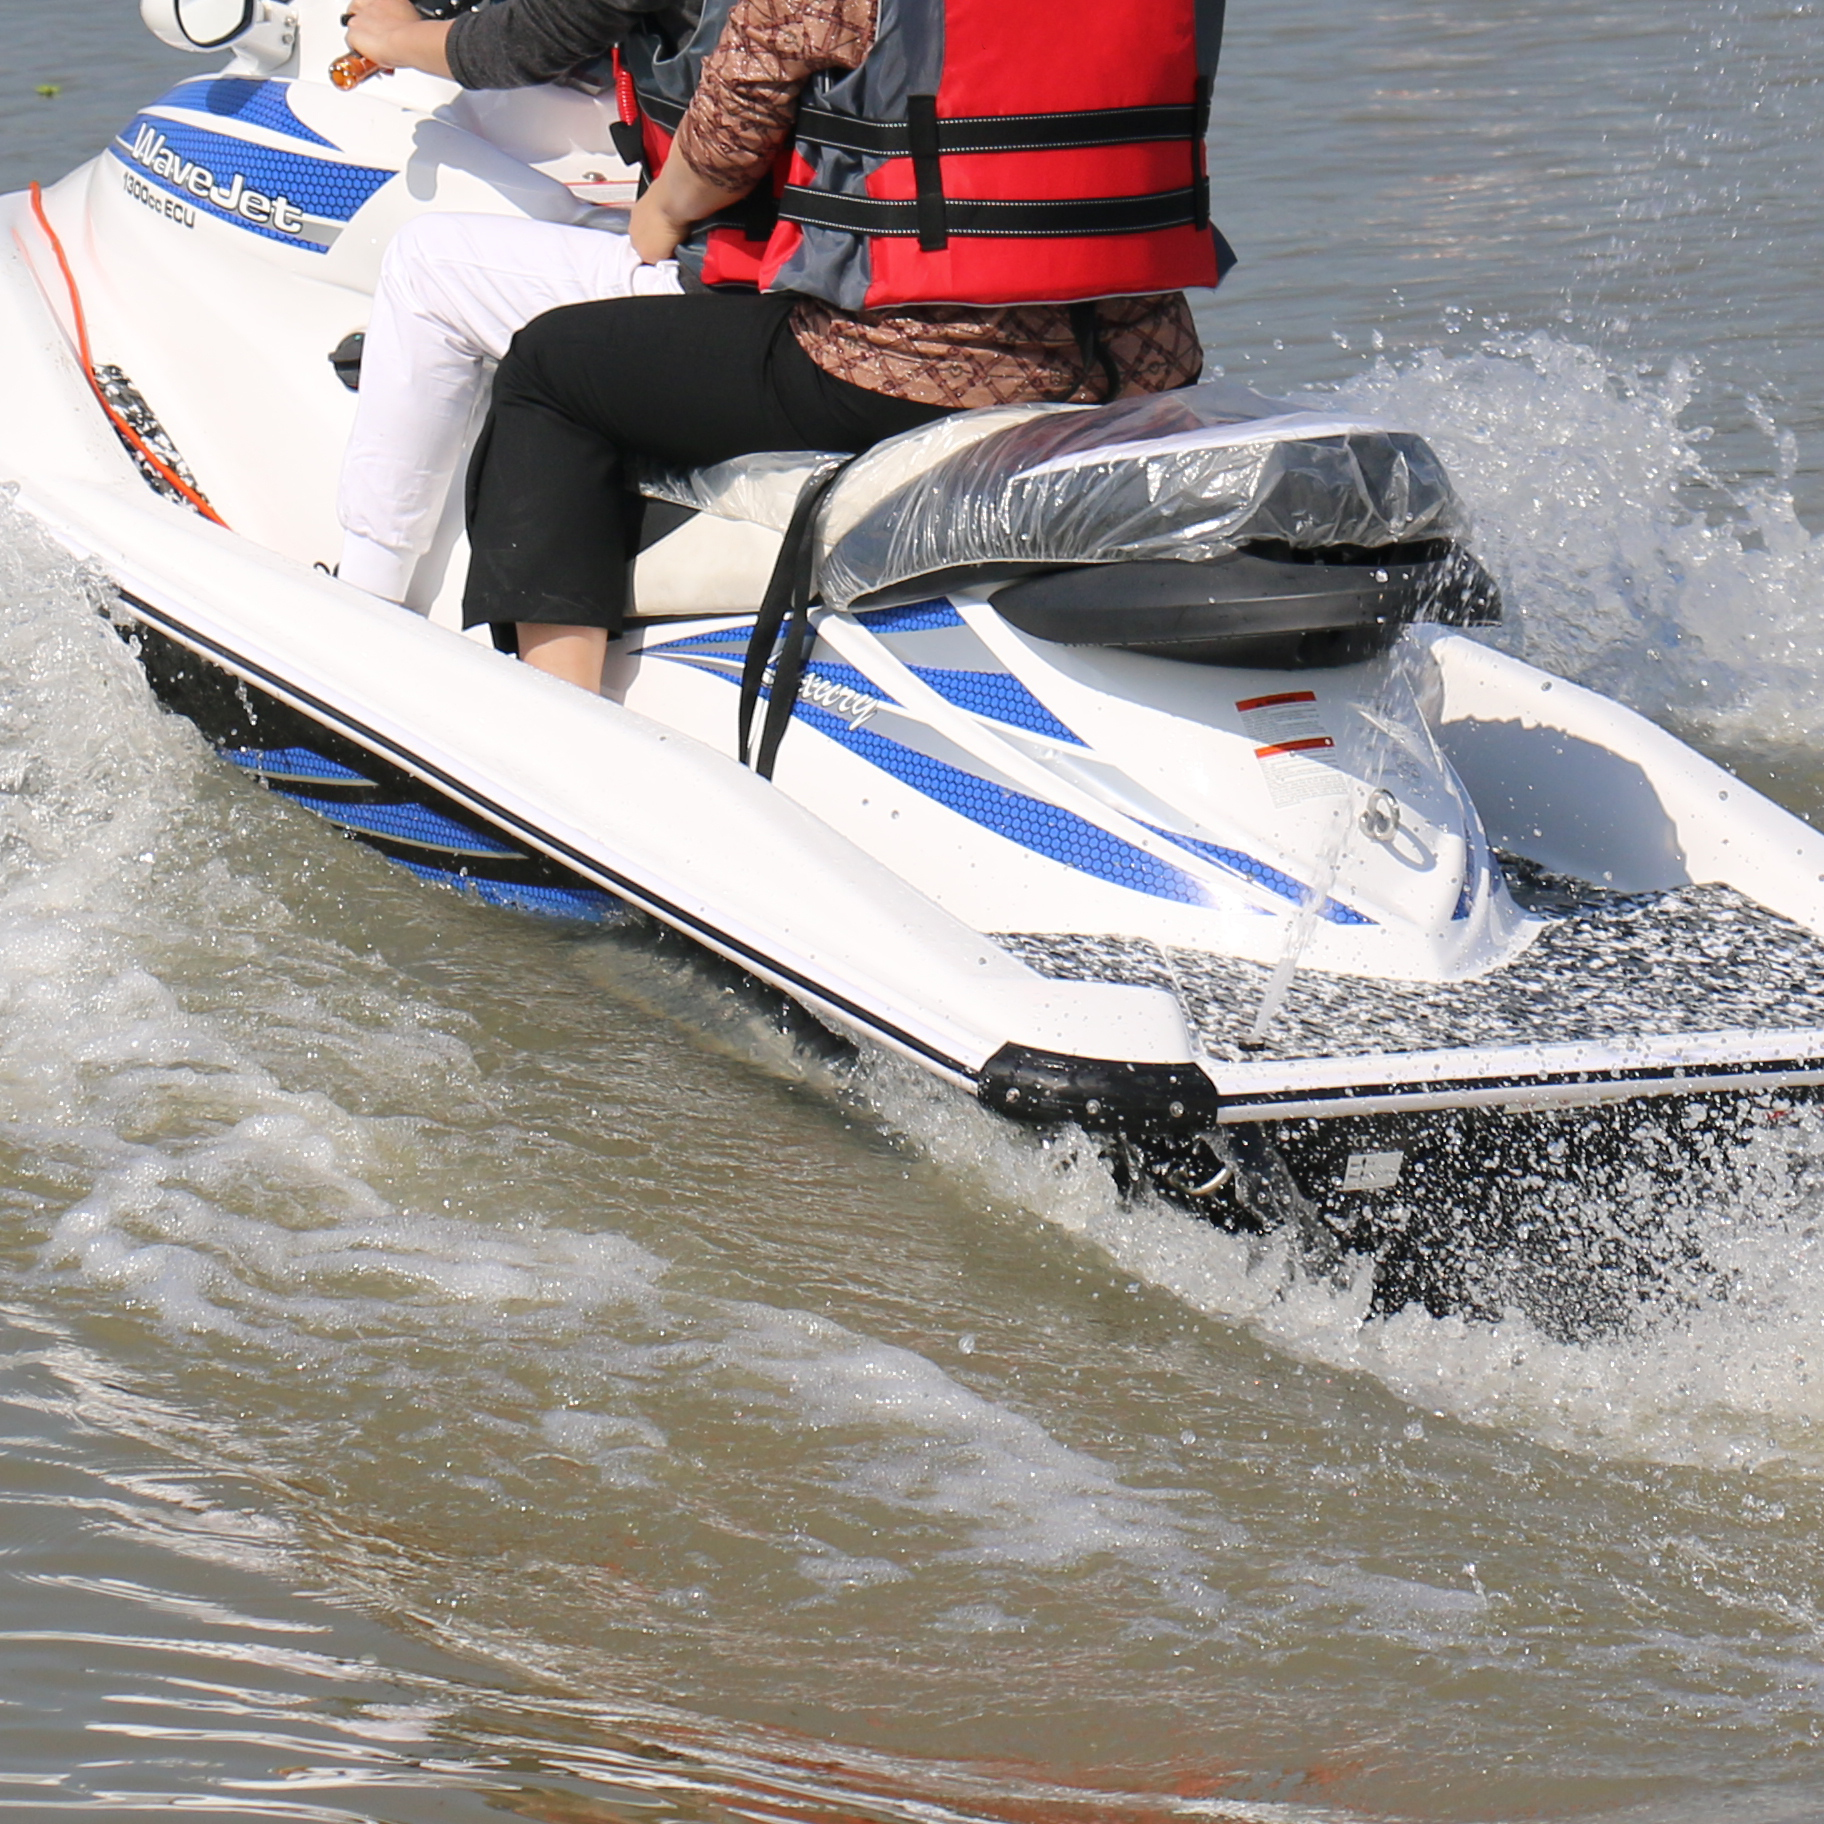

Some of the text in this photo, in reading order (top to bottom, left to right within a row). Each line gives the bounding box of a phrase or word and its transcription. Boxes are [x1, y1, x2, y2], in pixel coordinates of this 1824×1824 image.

[123, 171, 196, 229] 1300cc ECU
[130, 121, 304, 234] WaveJet
